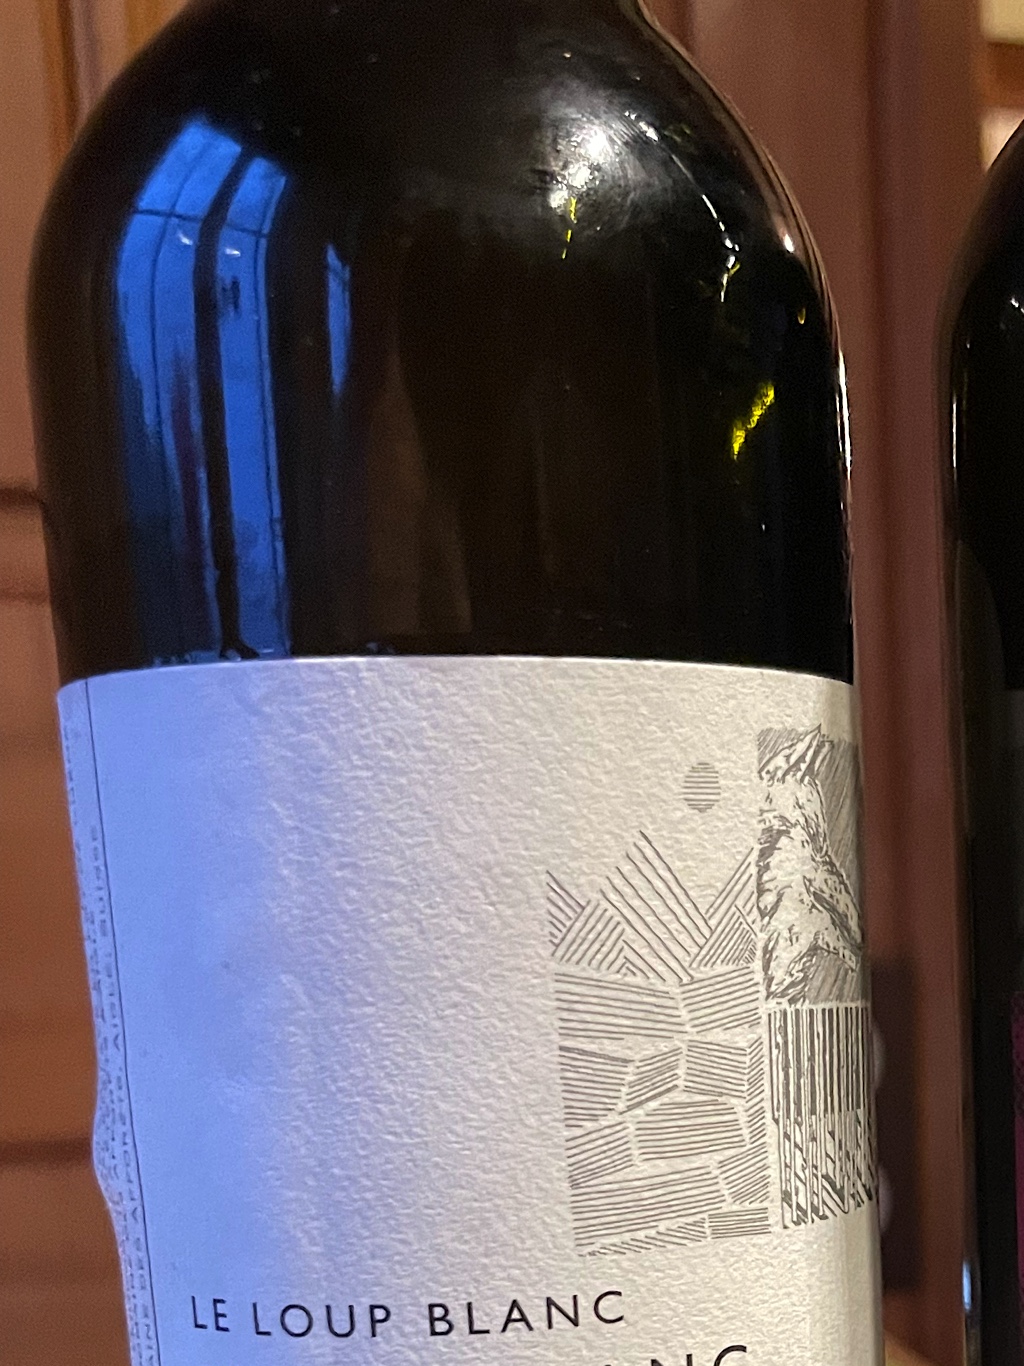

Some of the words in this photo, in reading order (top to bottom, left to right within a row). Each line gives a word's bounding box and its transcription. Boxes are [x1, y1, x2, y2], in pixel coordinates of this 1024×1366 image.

[189, 1295, 232, 1333] LE
[252, 1301, 394, 1341] LOUP
[427, 1290, 627, 1339] BLANC
